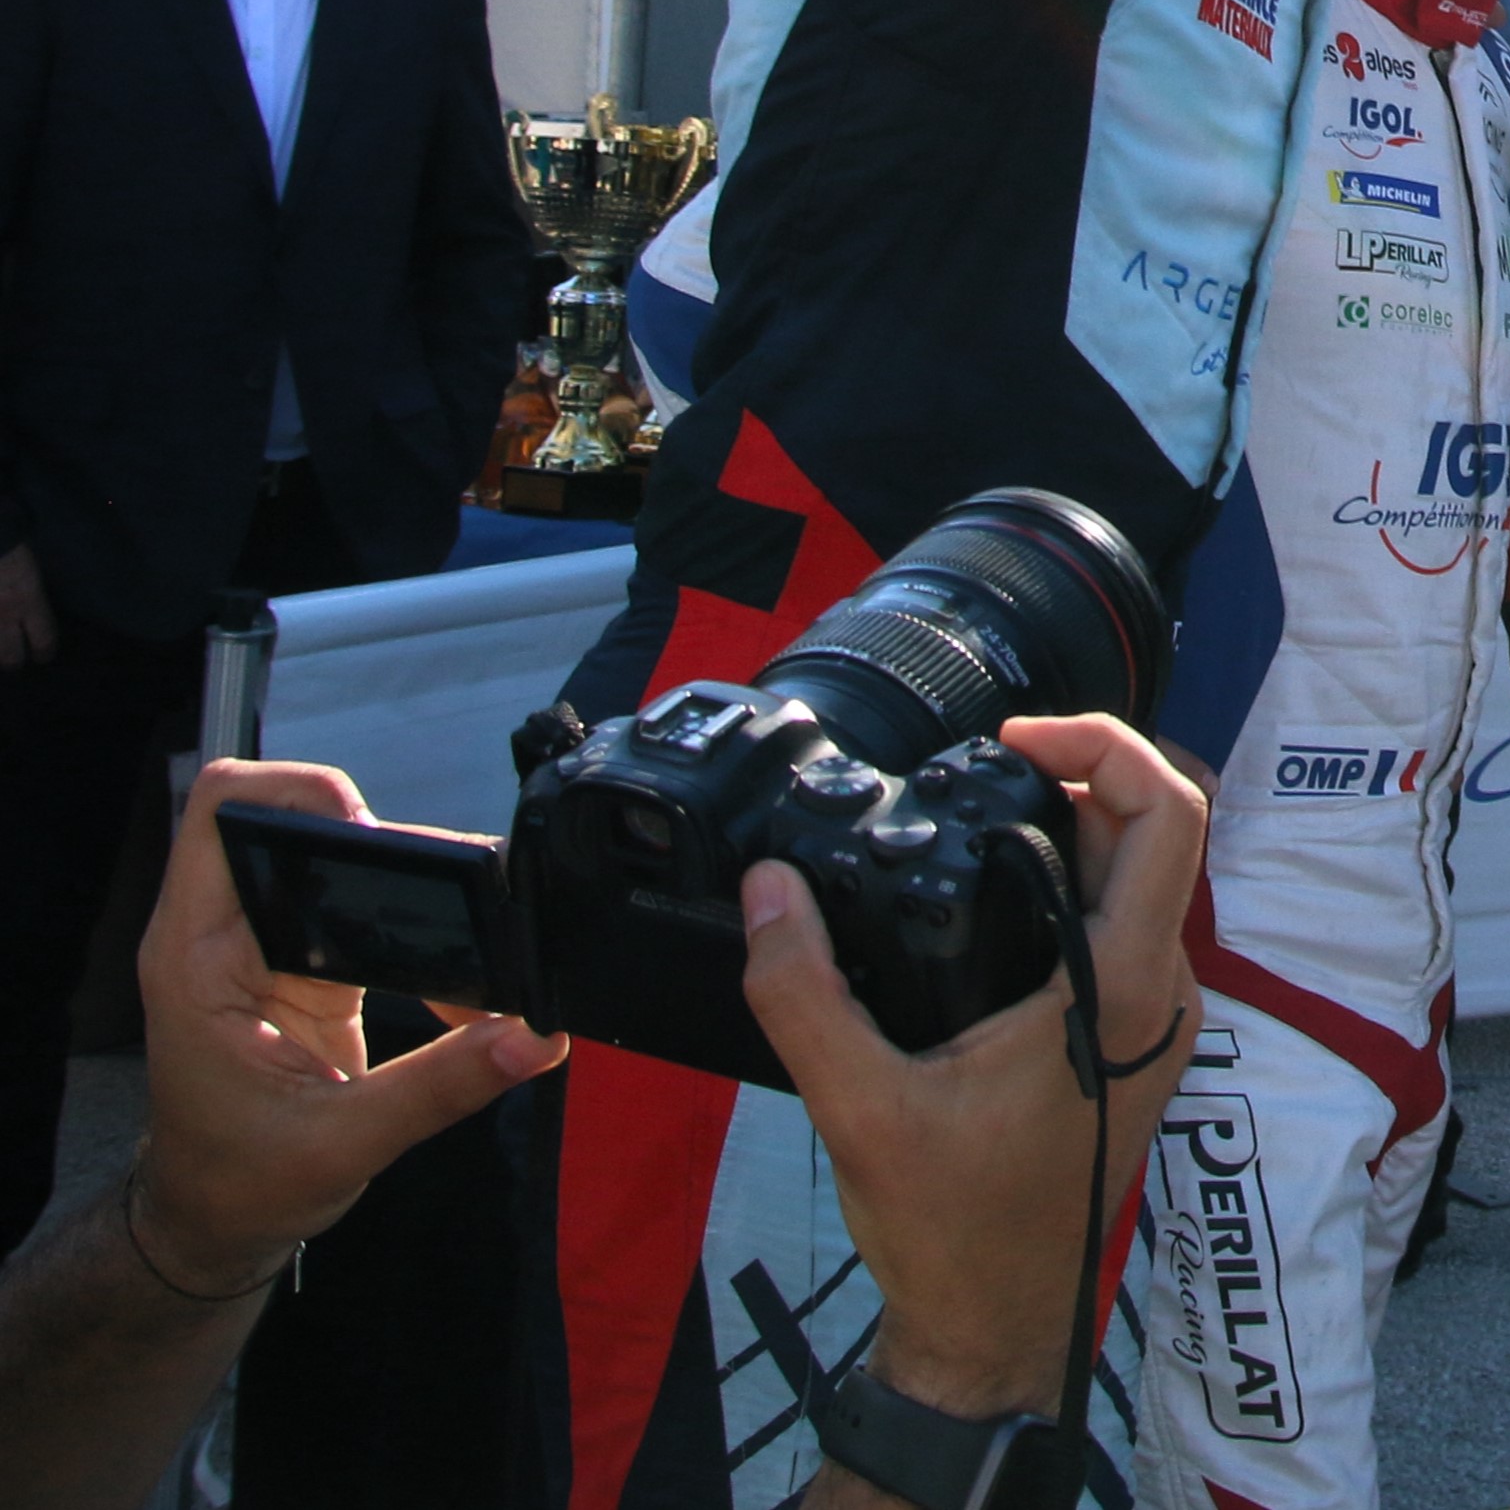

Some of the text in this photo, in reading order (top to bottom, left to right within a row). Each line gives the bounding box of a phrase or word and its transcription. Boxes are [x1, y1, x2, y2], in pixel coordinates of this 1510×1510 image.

[1365, 47, 1416, 80] alpes
[1367, 183, 1432, 208] MICHELIN
[1381, 302, 1453, 328] corelec
[1277, 755, 1366, 791] OMP
